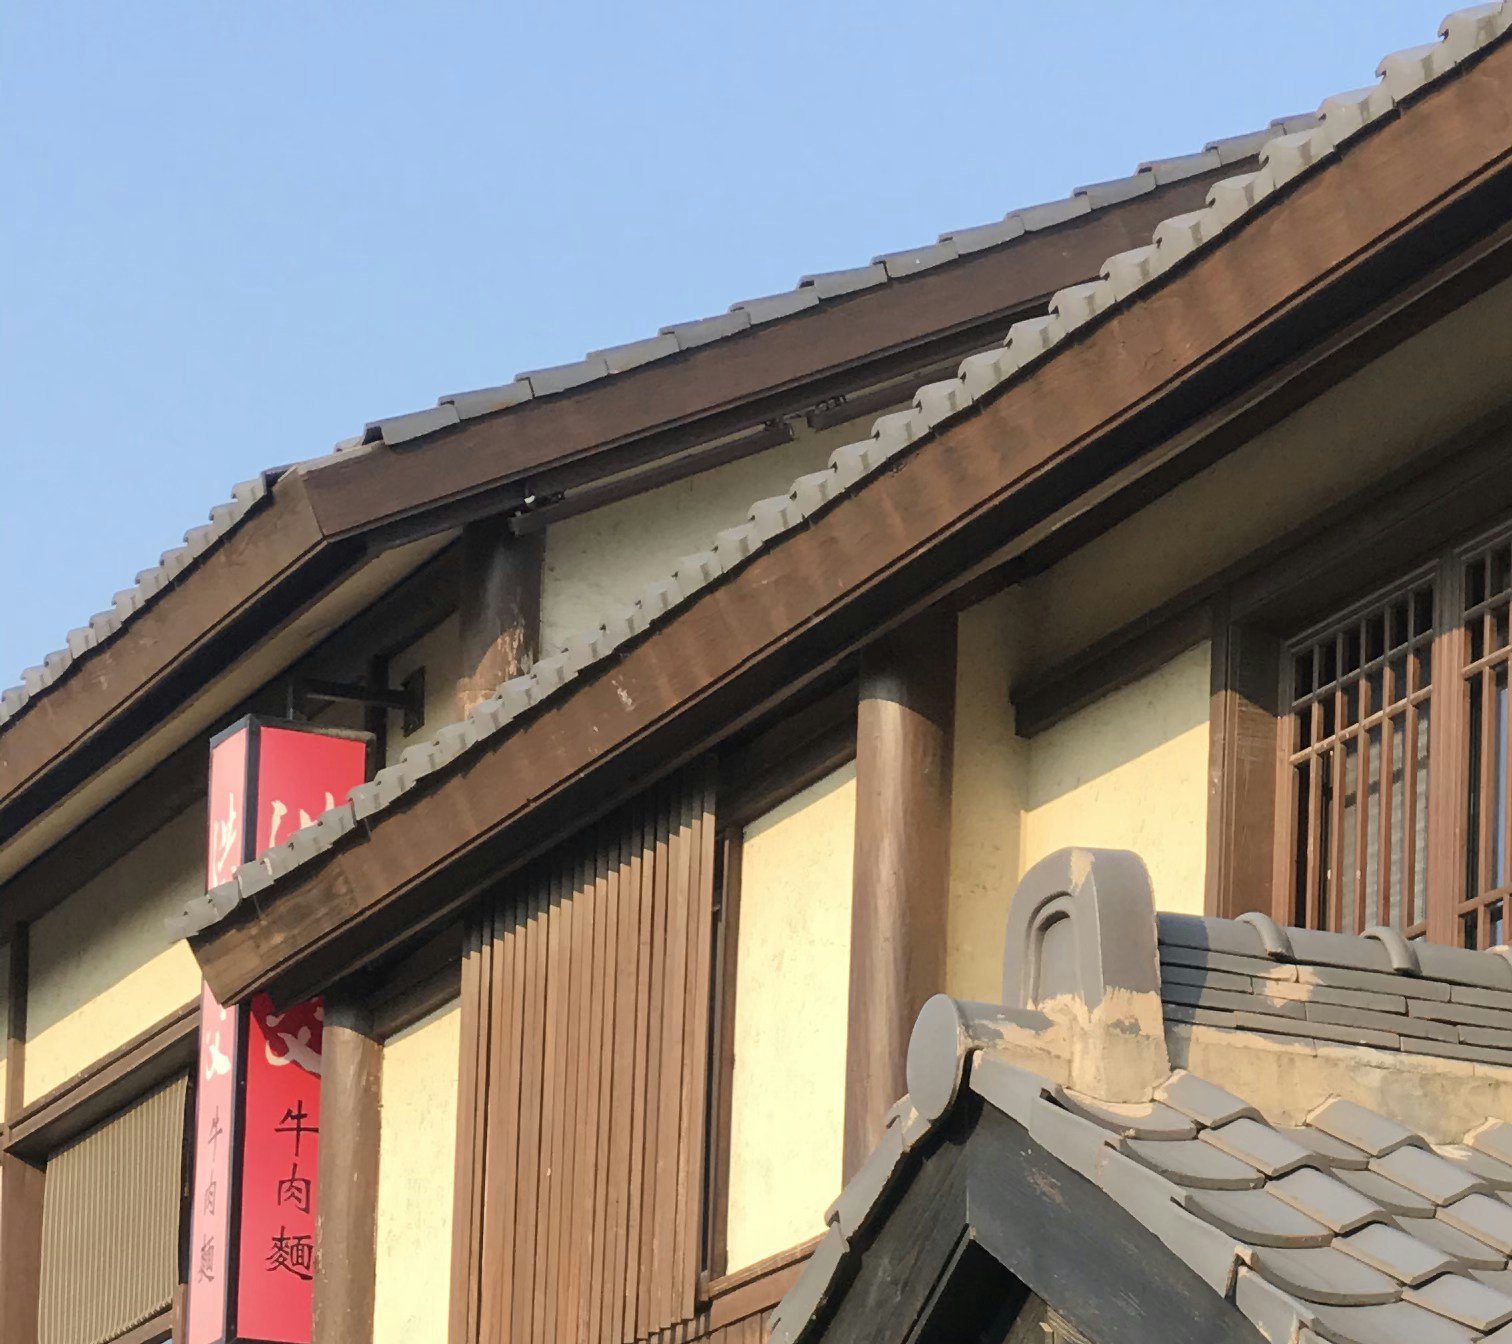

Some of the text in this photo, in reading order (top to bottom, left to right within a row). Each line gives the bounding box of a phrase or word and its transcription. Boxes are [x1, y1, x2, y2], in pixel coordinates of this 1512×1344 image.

[199, 1105, 222, 1284] 牛肉麵
[266, 1099, 320, 1282] 牛肉麵
